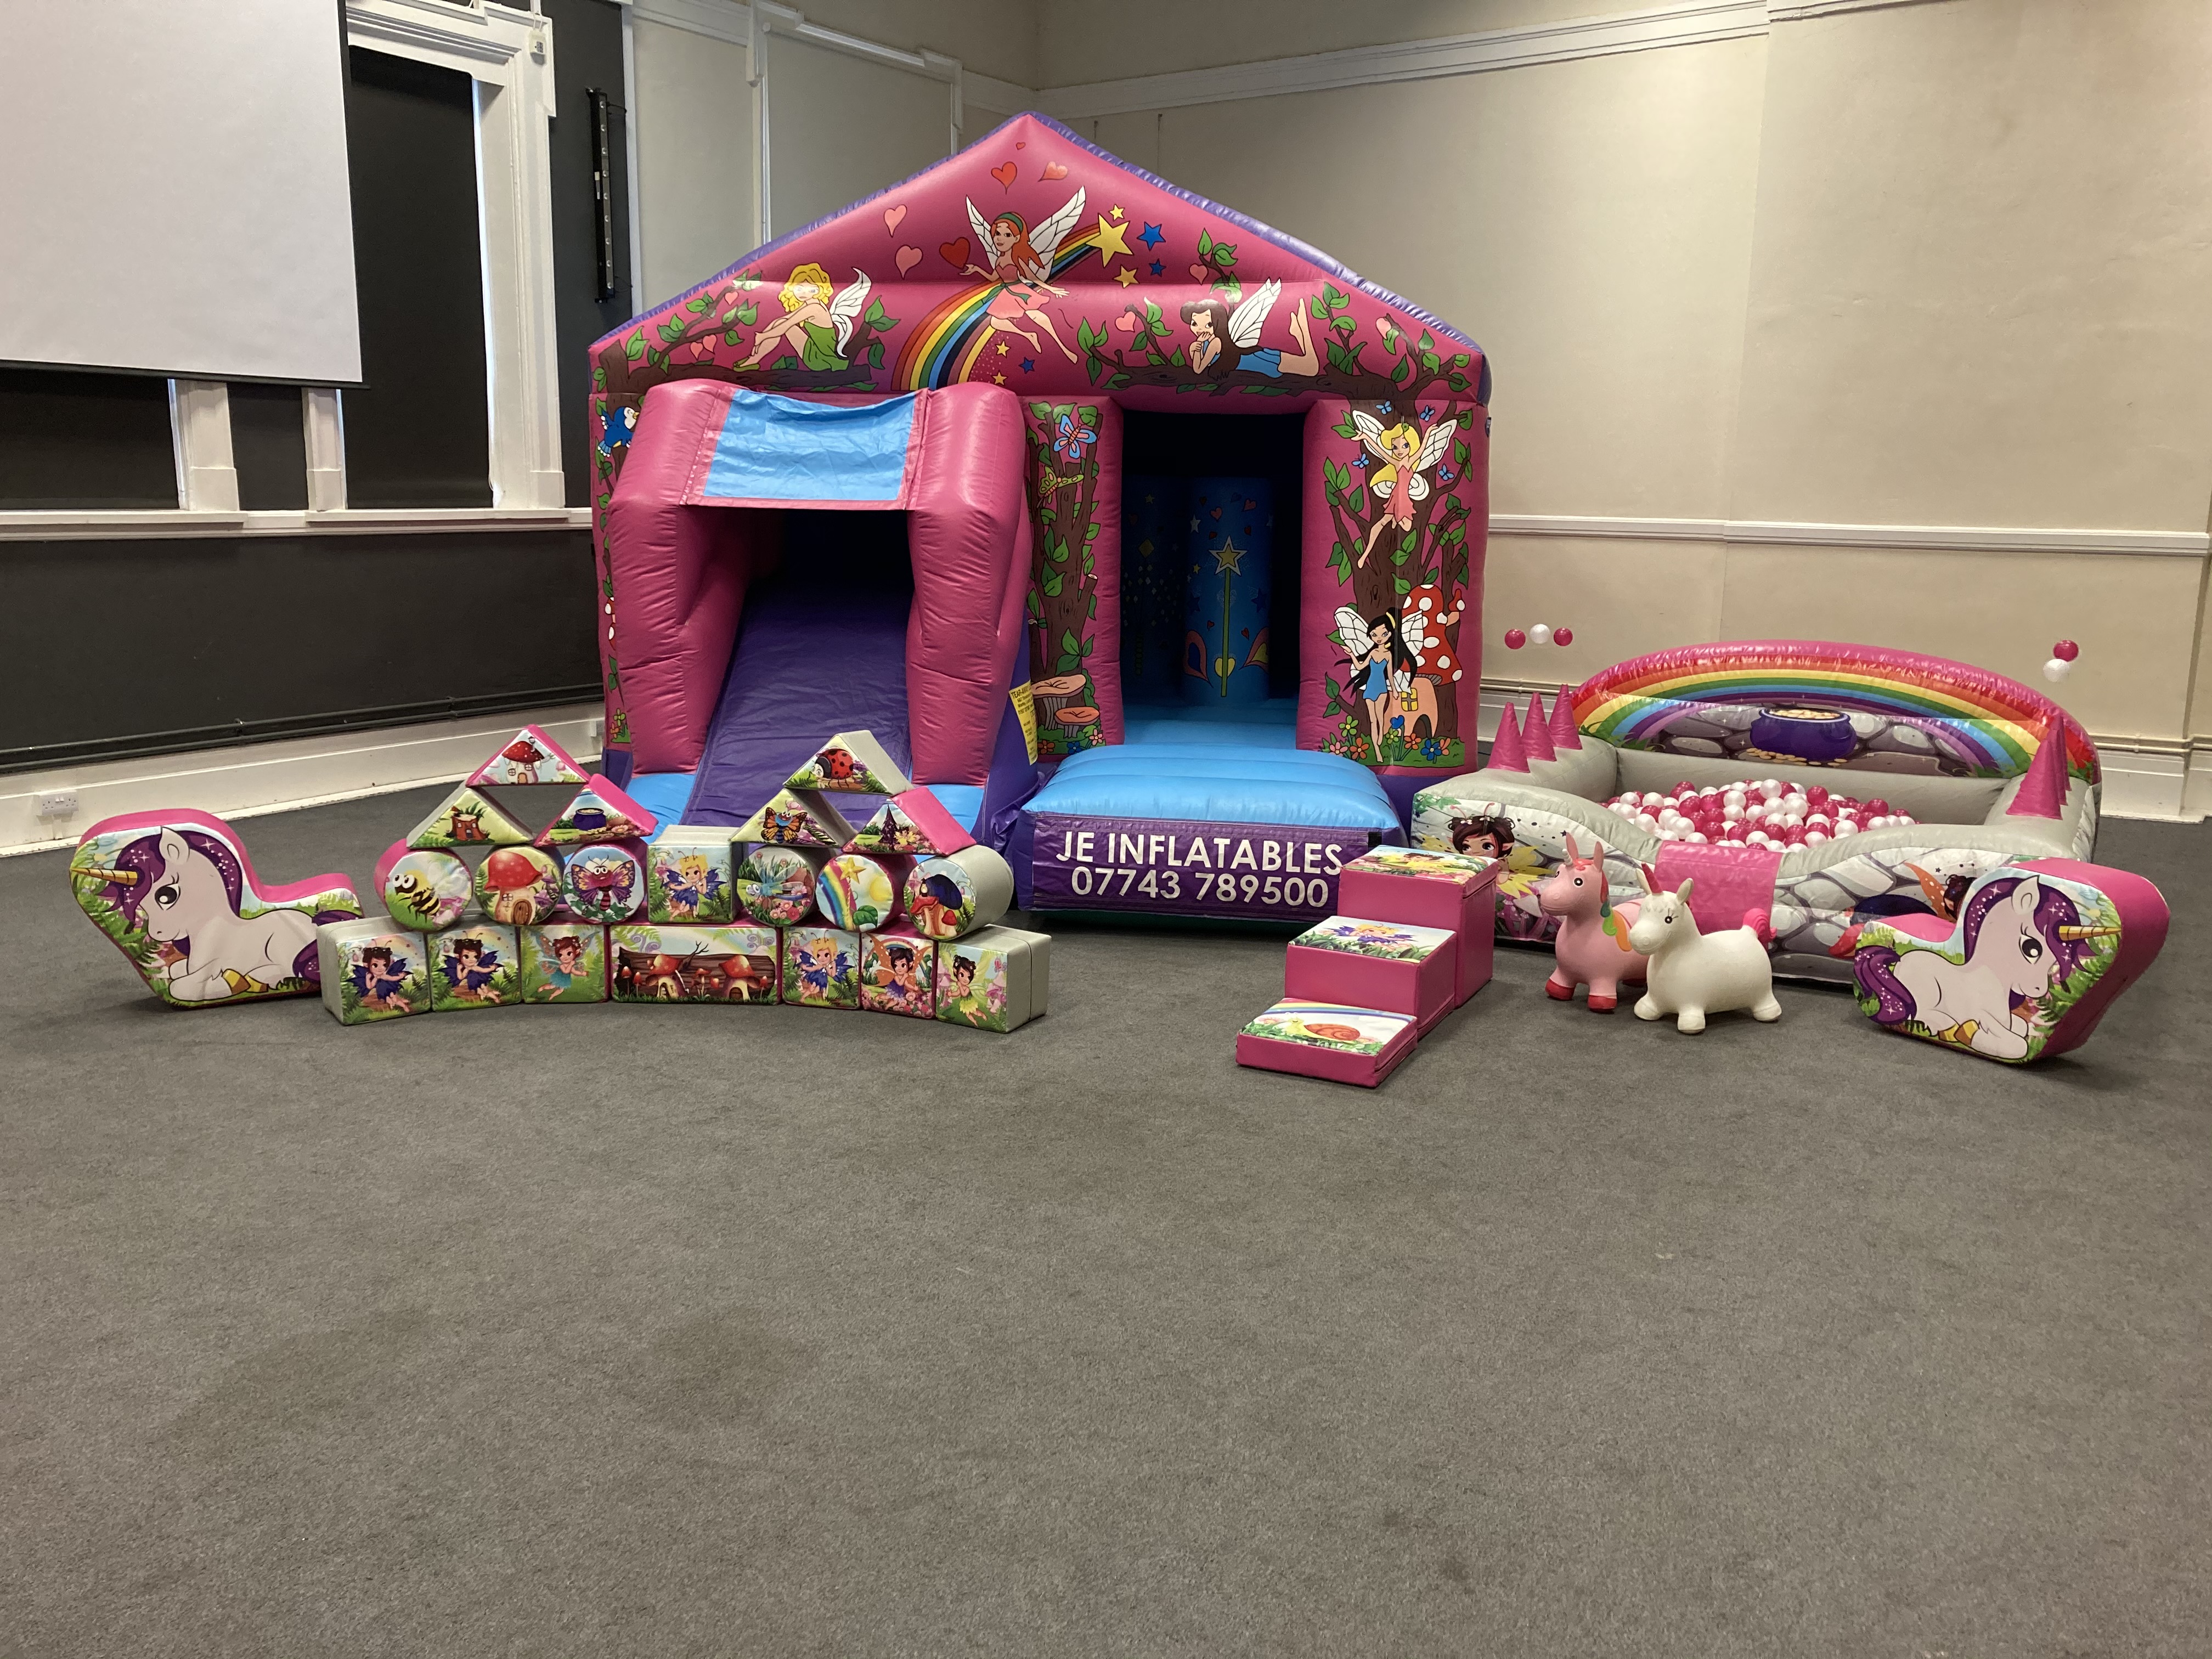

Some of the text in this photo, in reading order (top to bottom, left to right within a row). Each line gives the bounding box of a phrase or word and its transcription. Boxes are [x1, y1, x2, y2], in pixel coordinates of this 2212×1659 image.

[1056, 831, 1342, 875] JE INFLATABLES
[1071, 866, 1328, 907] 07743 789500
